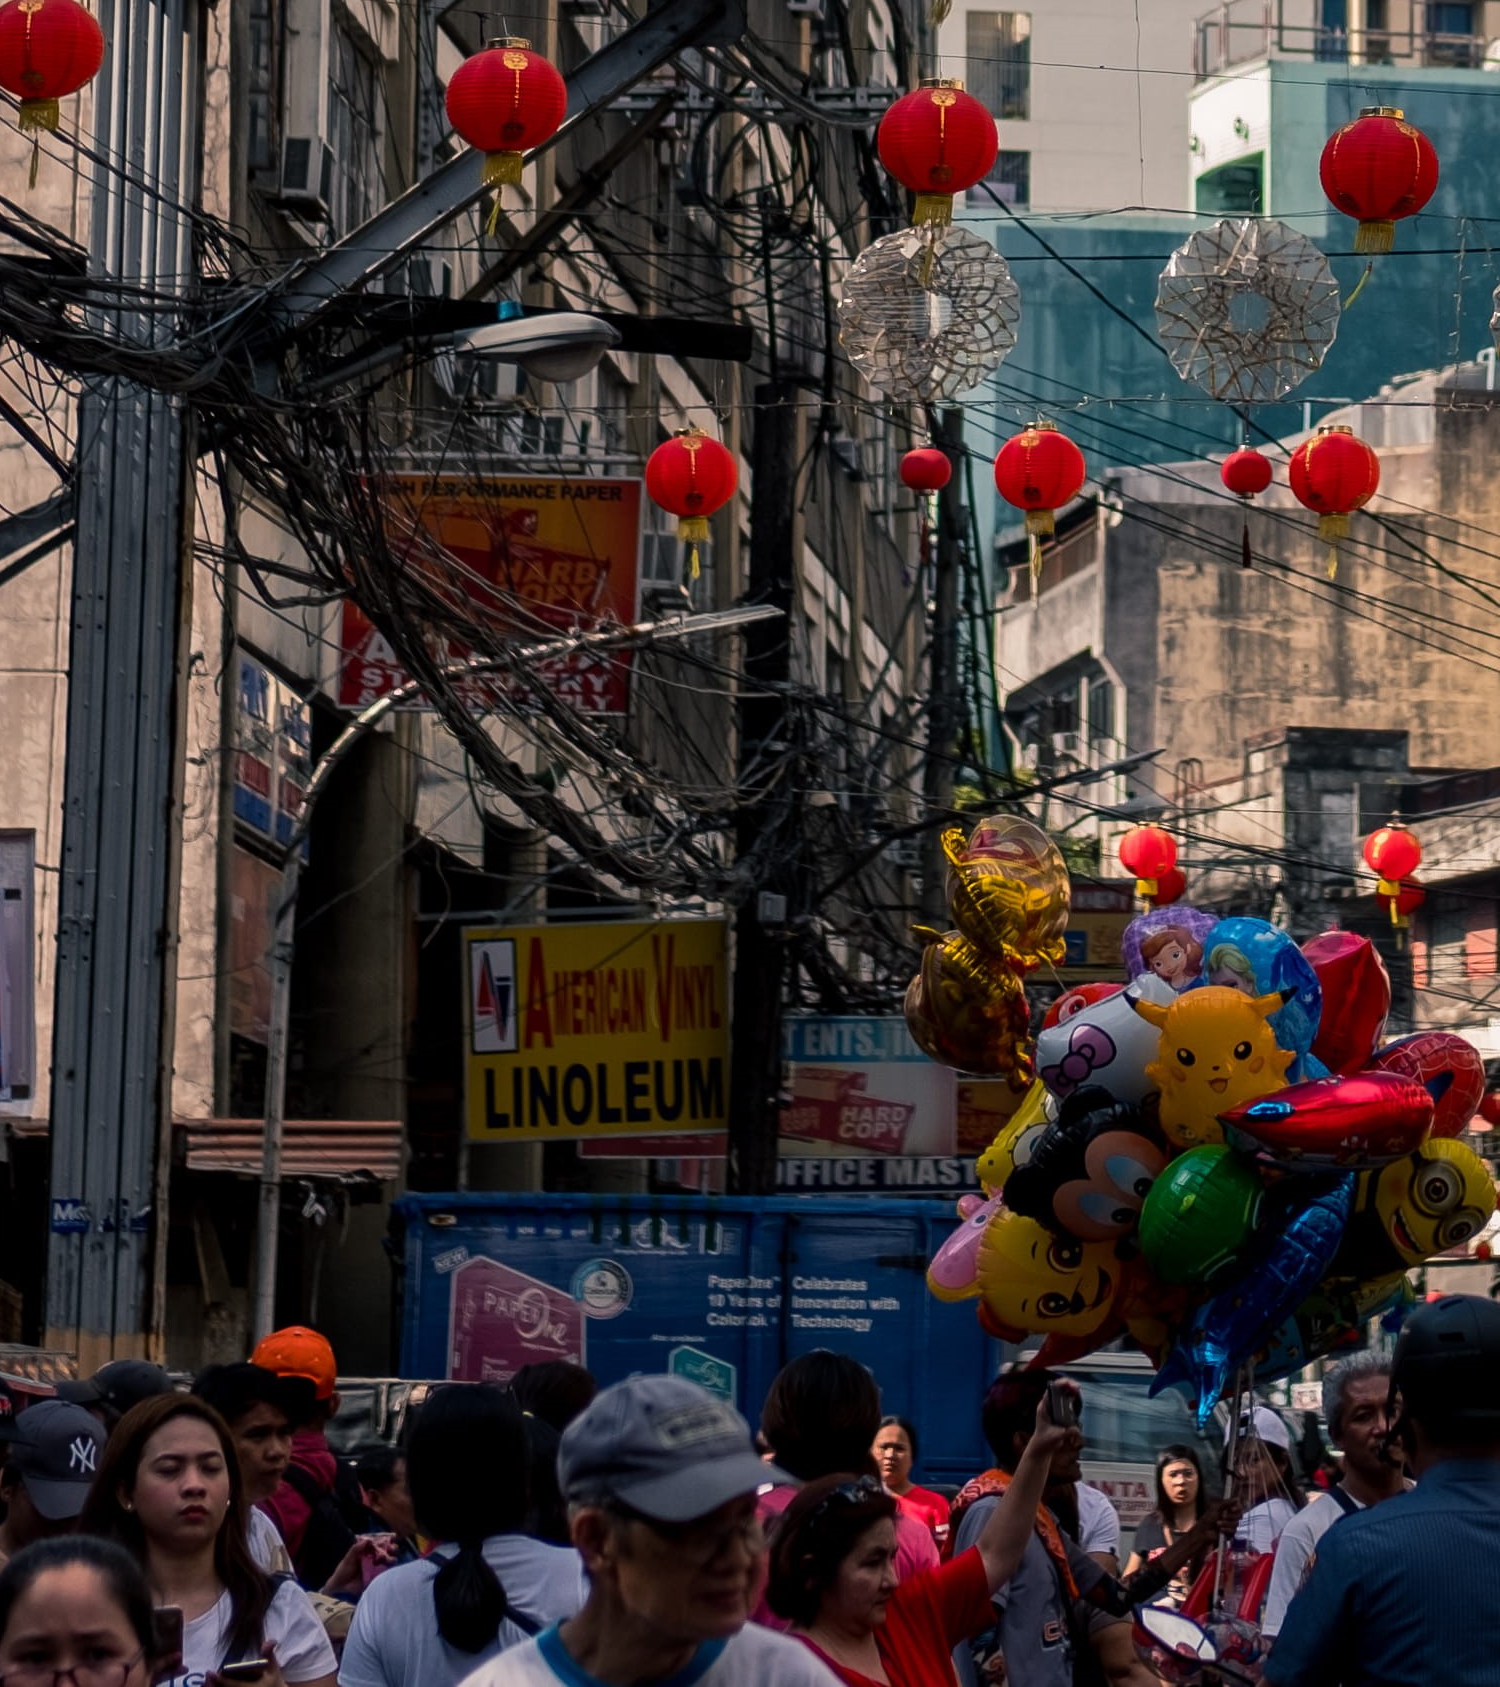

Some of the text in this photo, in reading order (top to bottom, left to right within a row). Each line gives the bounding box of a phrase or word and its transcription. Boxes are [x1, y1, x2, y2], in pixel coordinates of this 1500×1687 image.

[561, 484, 623, 501] PAPER
[524, 933, 720, 1048] AMERICAN VINYL
[484, 1058, 724, 1128] LINOLEUM
[838, 1105, 907, 1122] HARD
[837, 1121, 907, 1139] COPY
[883, 1157, 979, 1186] MAST
[792, 1276, 868, 1291] Celebrates
[483, 1290, 540, 1325] PAPER
[707, 1293, 901, 1311] 10 Years of Innovation with
[792, 1314, 873, 1333] Technology
[69, 1435, 97, 1473] NY
